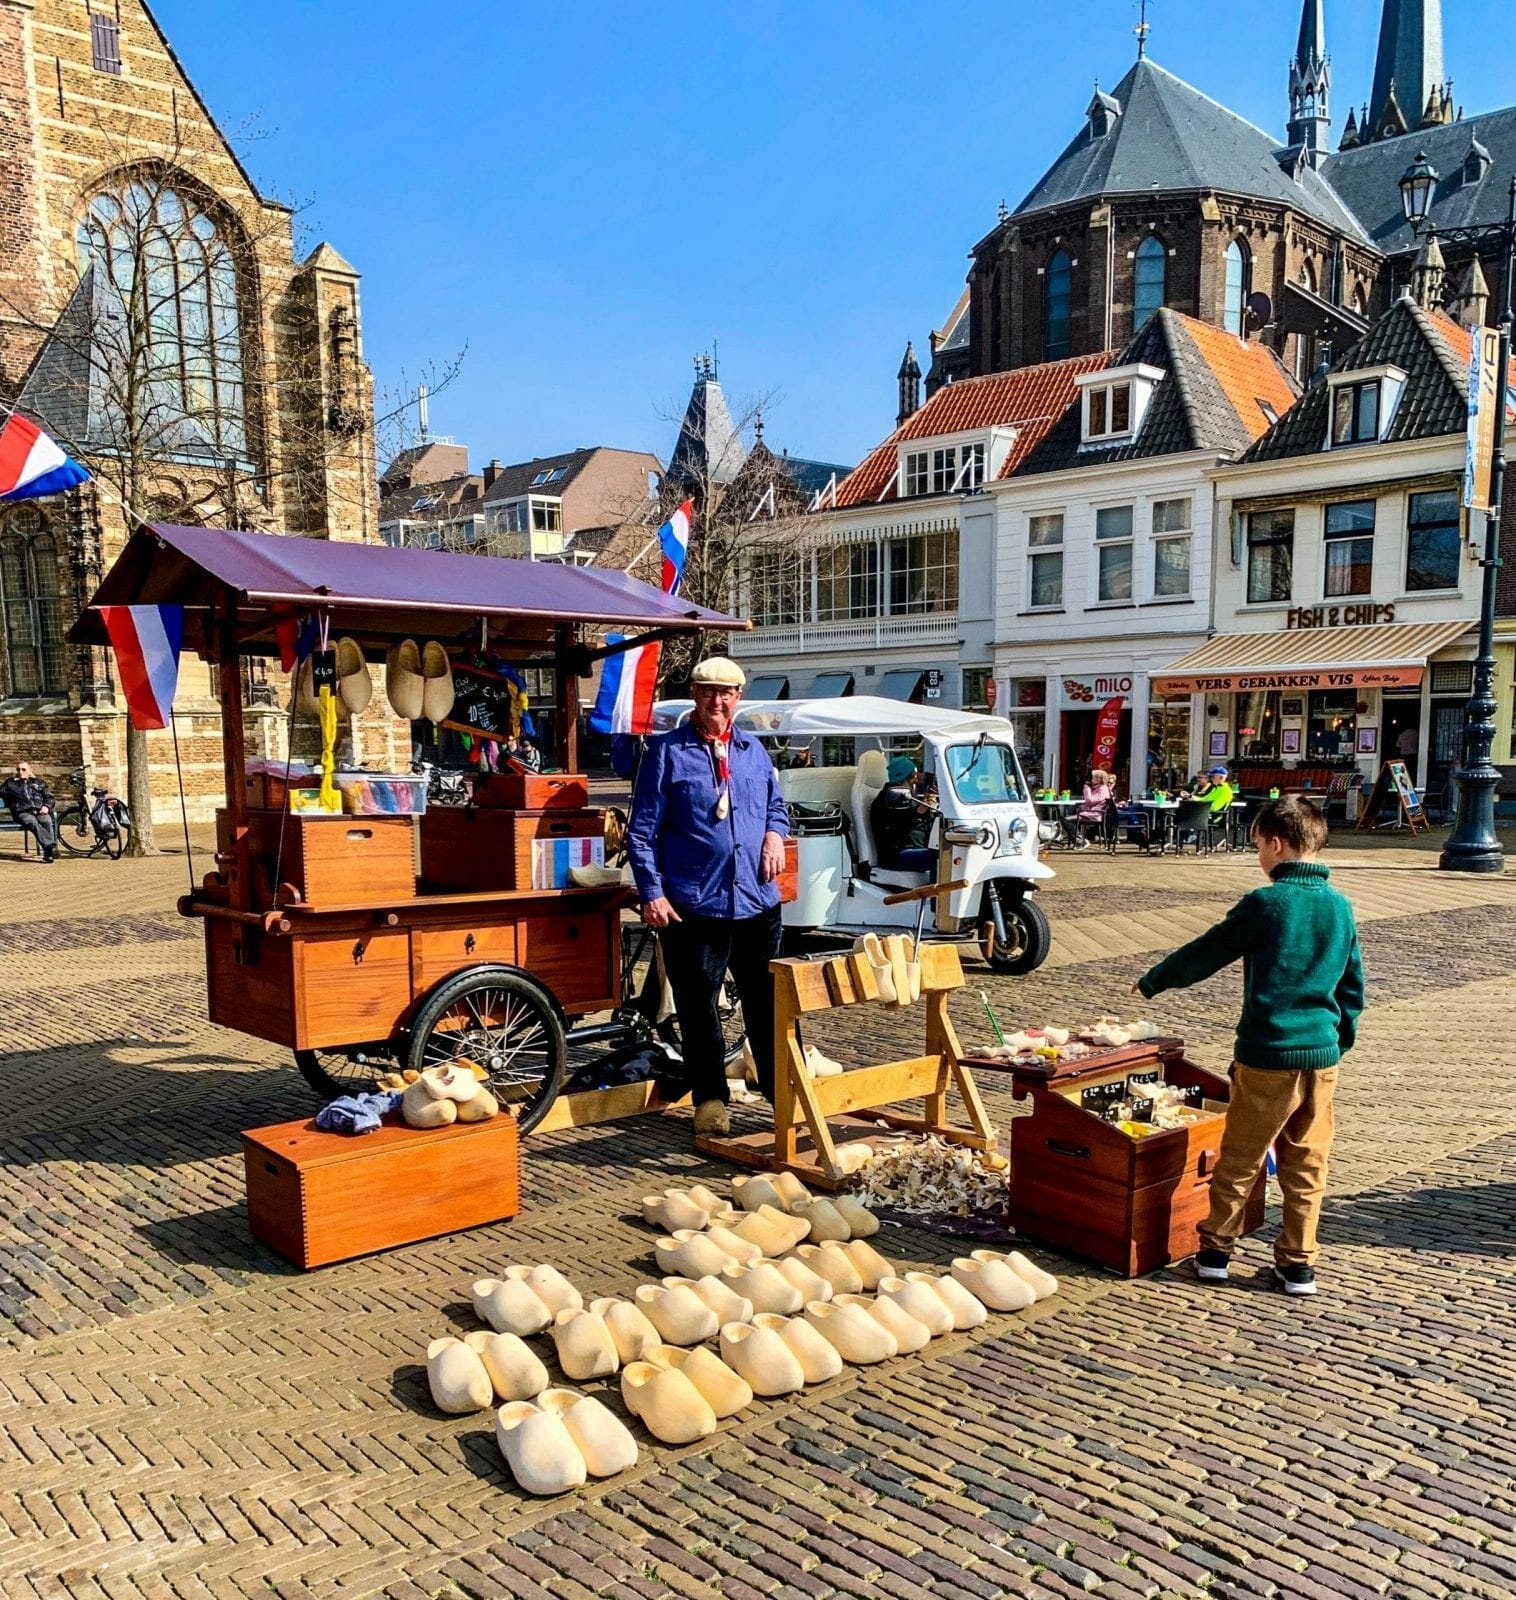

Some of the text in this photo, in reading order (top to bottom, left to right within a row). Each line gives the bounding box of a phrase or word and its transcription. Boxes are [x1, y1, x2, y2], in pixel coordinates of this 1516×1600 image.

[1328, 608, 1339, 627] &
[1344, 604, 1395, 625] CHIPS
[1195, 674, 1354, 690] VERS GEBAKKEN VIS
